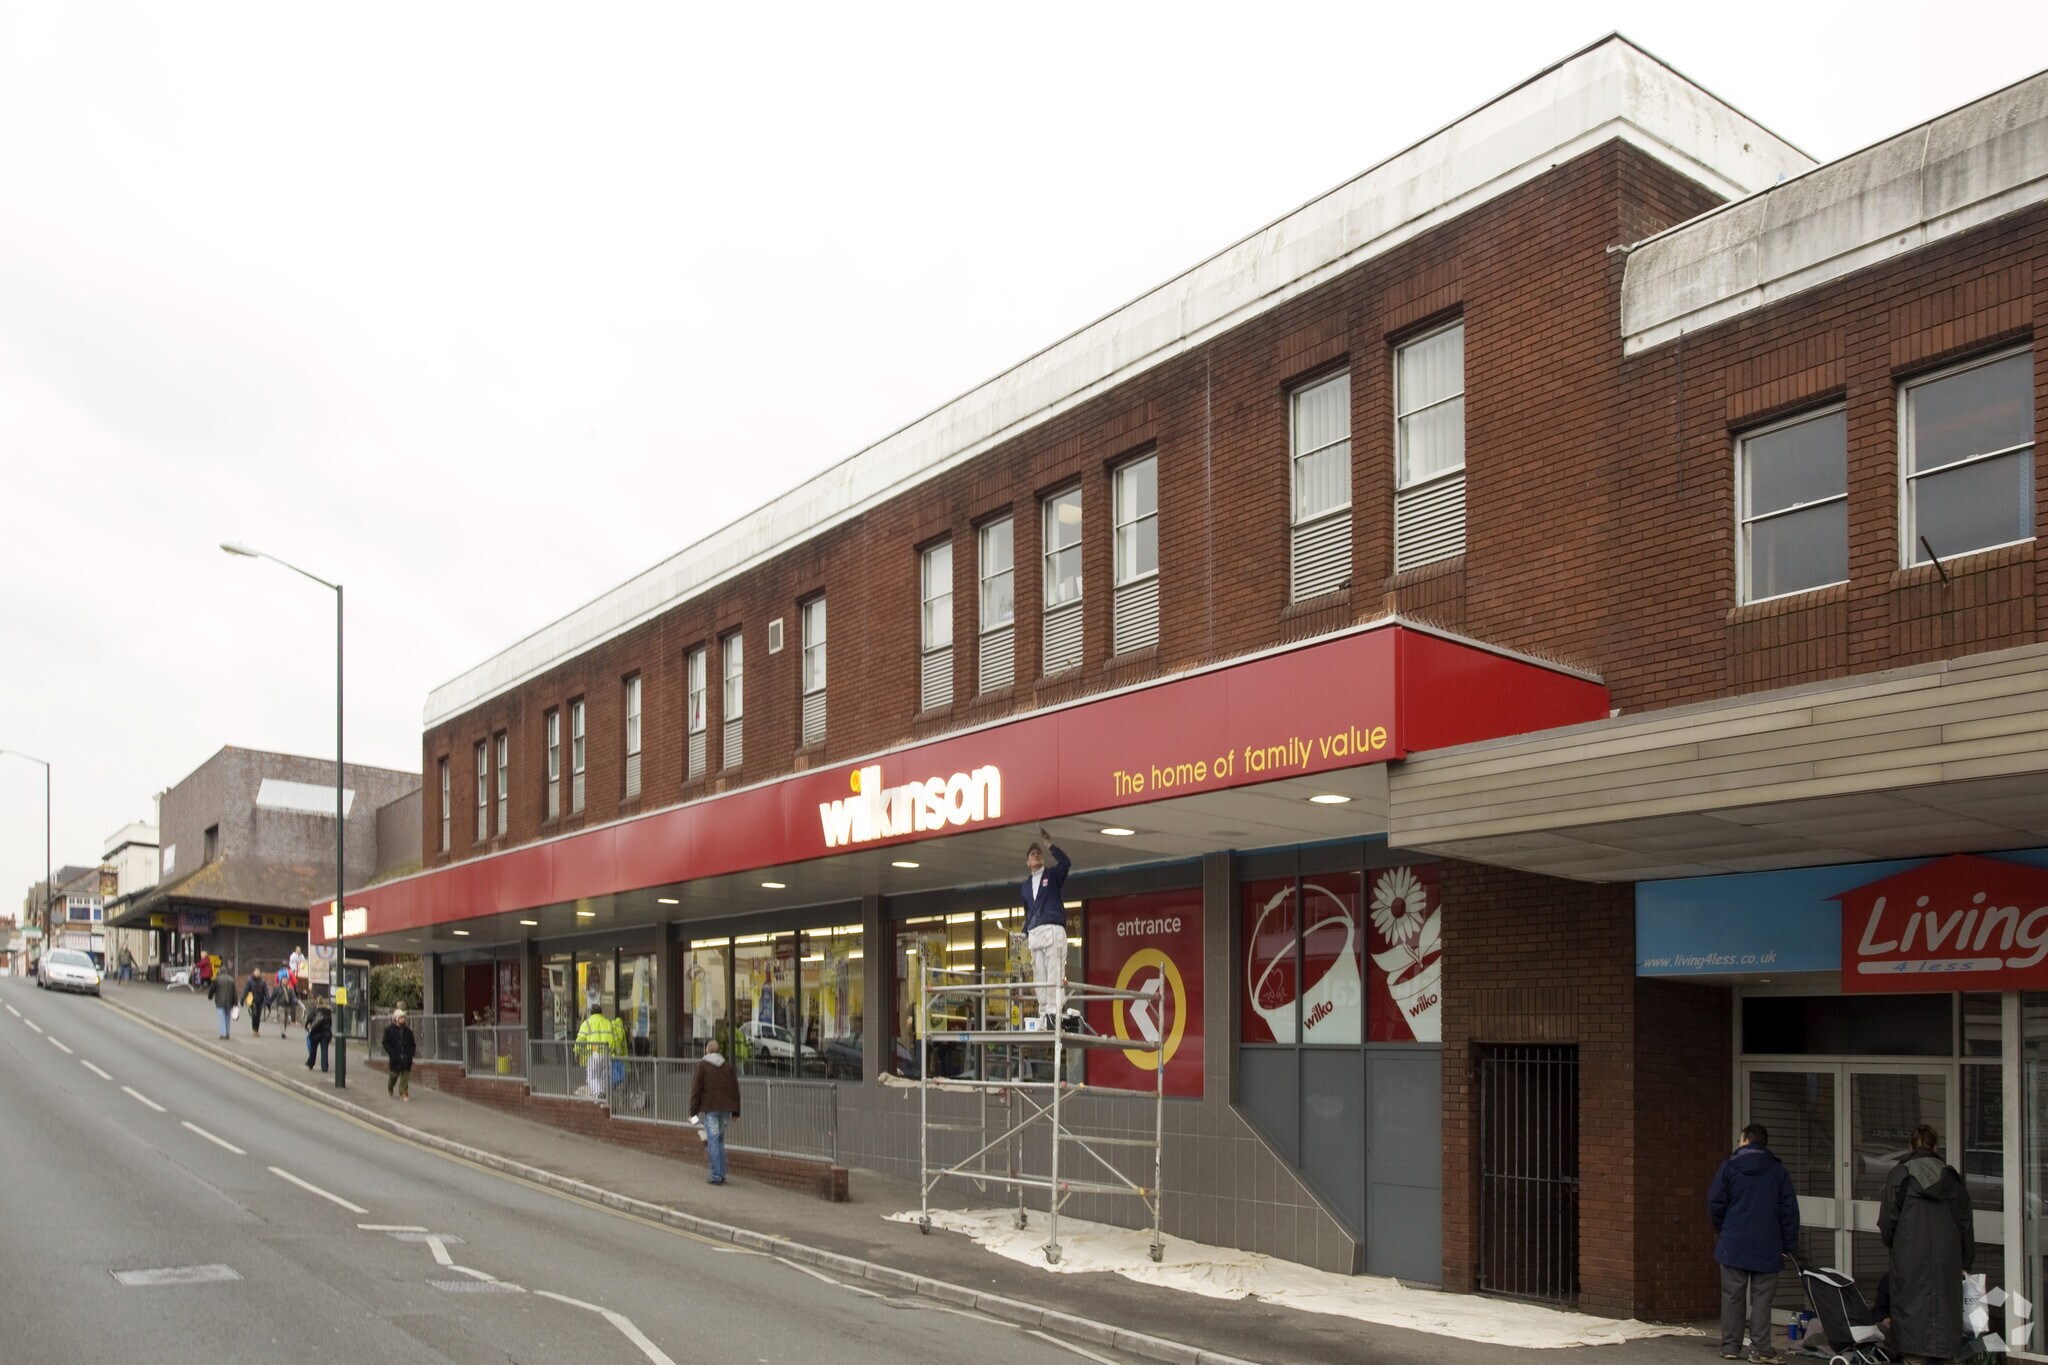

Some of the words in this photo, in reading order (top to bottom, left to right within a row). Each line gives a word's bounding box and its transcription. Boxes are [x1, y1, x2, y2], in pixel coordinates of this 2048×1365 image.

[1113, 770, 1145, 797] The
[1151, 759, 1208, 791] home
[1213, 749, 1235, 778] of
[1244, 736, 1313, 769] family
[1318, 725, 1388, 760] value
[818, 764, 1003, 848] wilkinson
[1116, 916, 1182, 937] entrance
[1857, 891, 2048, 969] Living
[1643, 950, 1777, 970] www.living4less.co.uk
[1892, 961, 1908, 973] 4
[1918, 961, 1975, 973] less
[1303, 1000, 1334, 1030] wilko
[1409, 993, 1438, 1018] wilko
